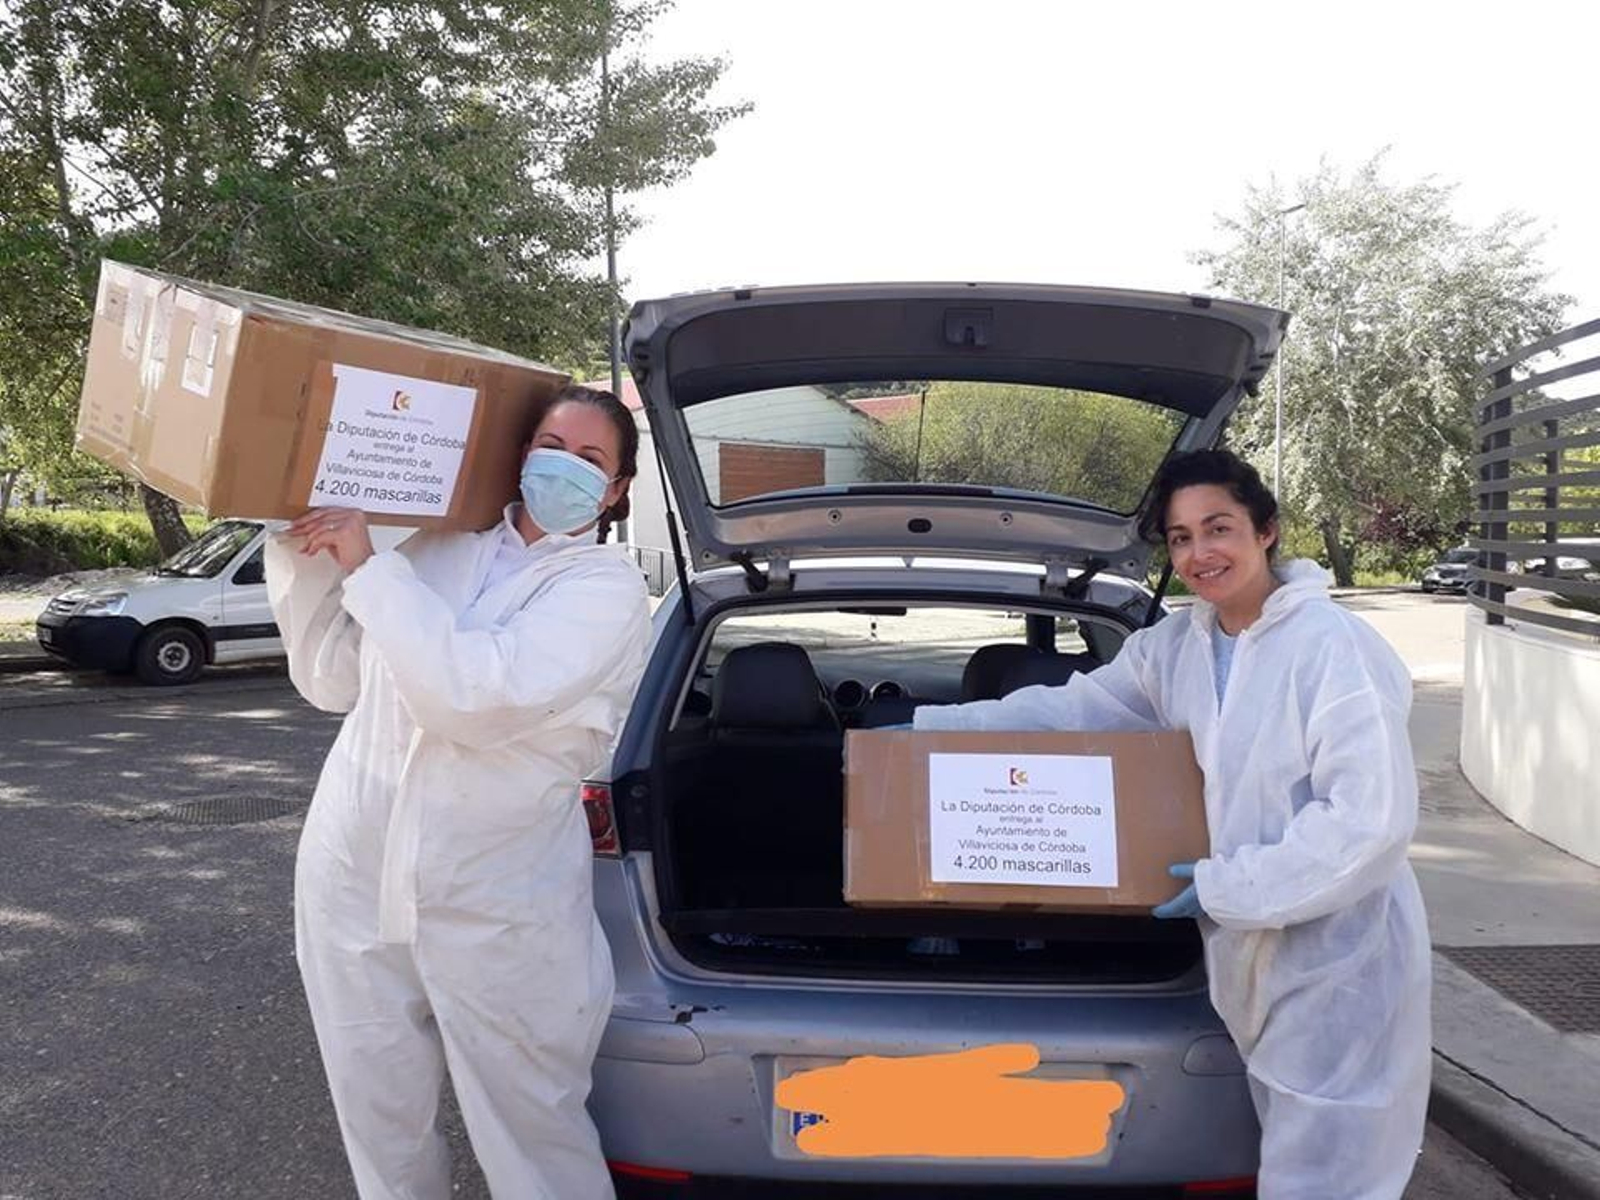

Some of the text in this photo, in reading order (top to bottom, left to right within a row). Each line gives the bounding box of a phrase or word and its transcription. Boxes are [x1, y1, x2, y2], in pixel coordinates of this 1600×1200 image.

[337, 421, 400, 440] Diputación
[403, 431, 418, 444] de
[421, 432, 466, 450] Córdoba
[373, 442, 405, 453] entrega
[346, 449, 432, 469] Ayuntamiento de
[326, 462, 443, 485] Villaviciosa de Córdoba
[315, 479, 442, 504] 4.200 mascarillas
[941, 800, 1102, 816] La Diputación de Córdoba
[999, 815, 1033, 825] entrega
[975, 825, 1067, 838] Ayuntamiento de
[958, 839, 1086, 854] Villaviciosa de Córdoba
[953, 855, 1092, 874] 4.200 mascarillas
